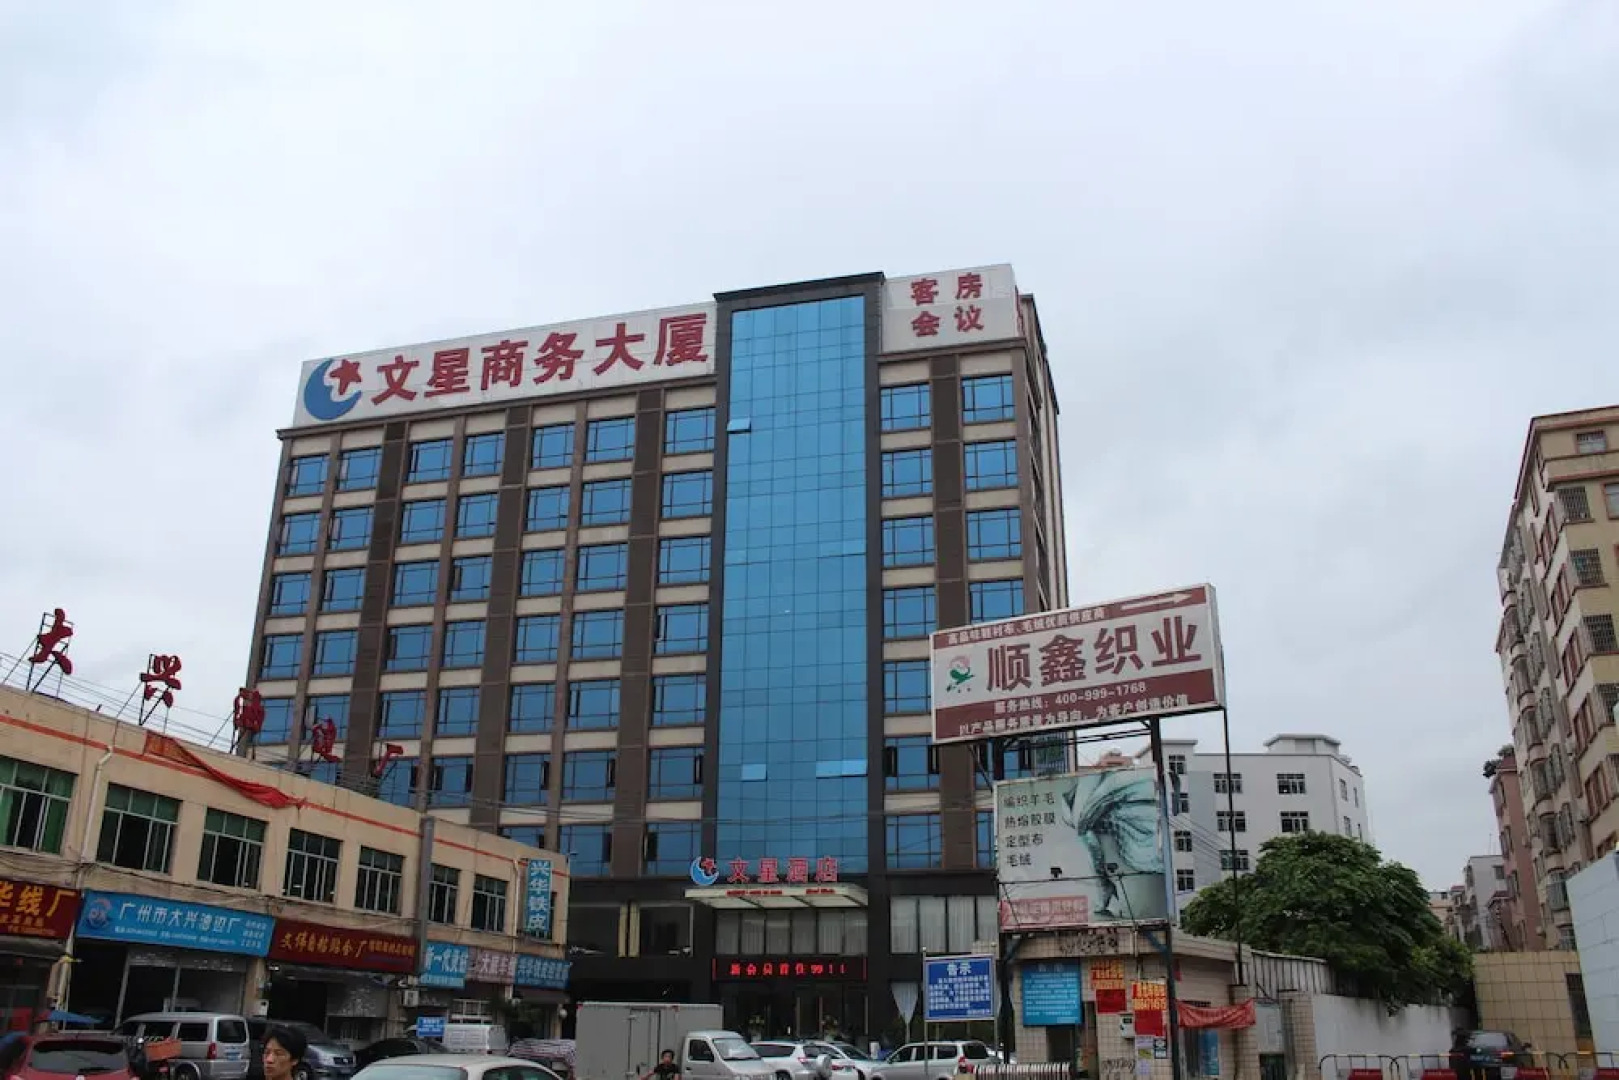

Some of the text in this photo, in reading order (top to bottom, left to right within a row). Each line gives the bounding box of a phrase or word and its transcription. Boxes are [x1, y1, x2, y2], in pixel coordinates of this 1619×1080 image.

[911, 272, 983, 306] 客房
[911, 304, 984, 337] 会议
[371, 312, 708, 405] 文星商务大厦
[987, 615, 1202, 692] 顺鑫织业
[1055, 681, 1147, 705] 400-999-1768
[727, 855, 838, 883] 文星酒店
